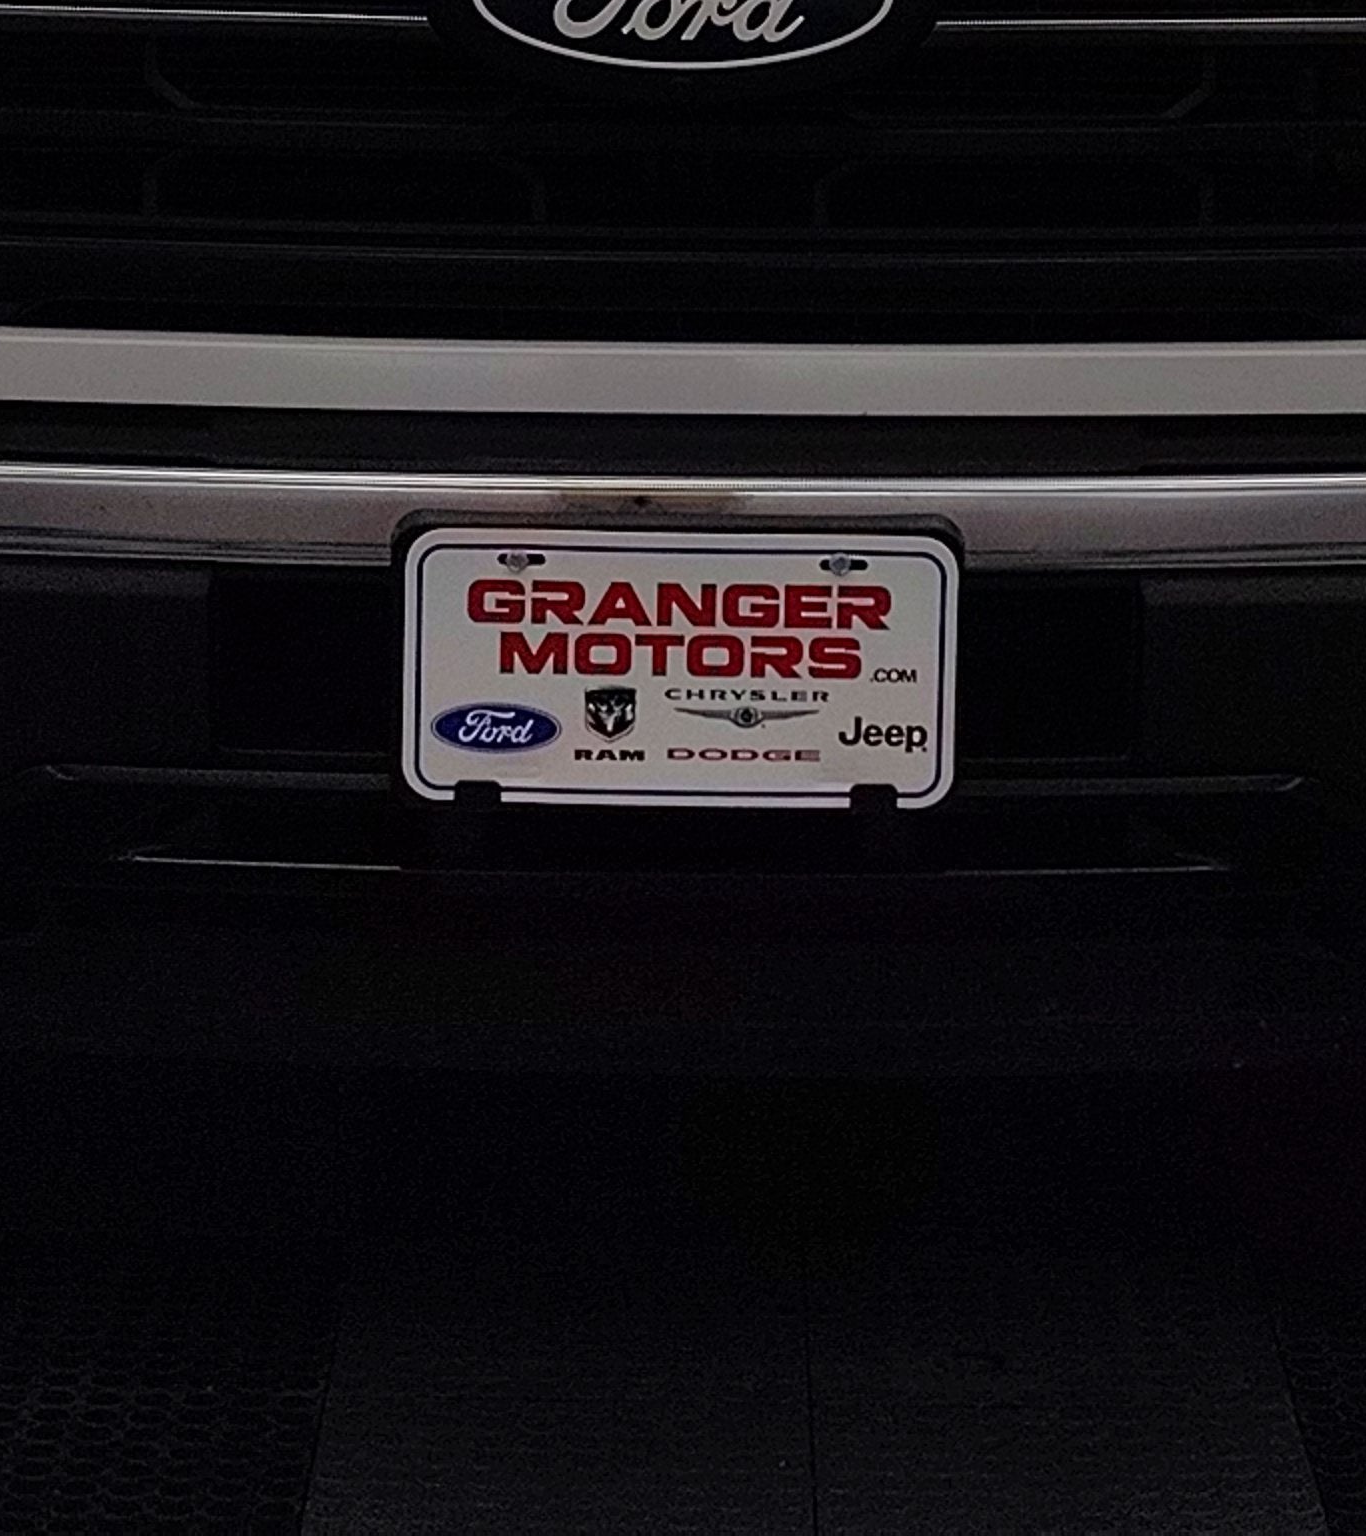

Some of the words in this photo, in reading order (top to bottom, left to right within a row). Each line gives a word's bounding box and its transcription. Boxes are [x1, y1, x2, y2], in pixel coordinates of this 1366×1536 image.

[467, 578, 892, 630] GRANGER
[498, 631, 862, 679] MOTORS
[869, 668, 918, 684] .COM
[664, 688, 830, 703] CHRYSLER
[458, 709, 534, 745] Ford
[838, 716, 928, 752] Jeep
[573, 749, 646, 762] RAM
[666, 748, 822, 762] DODGE
